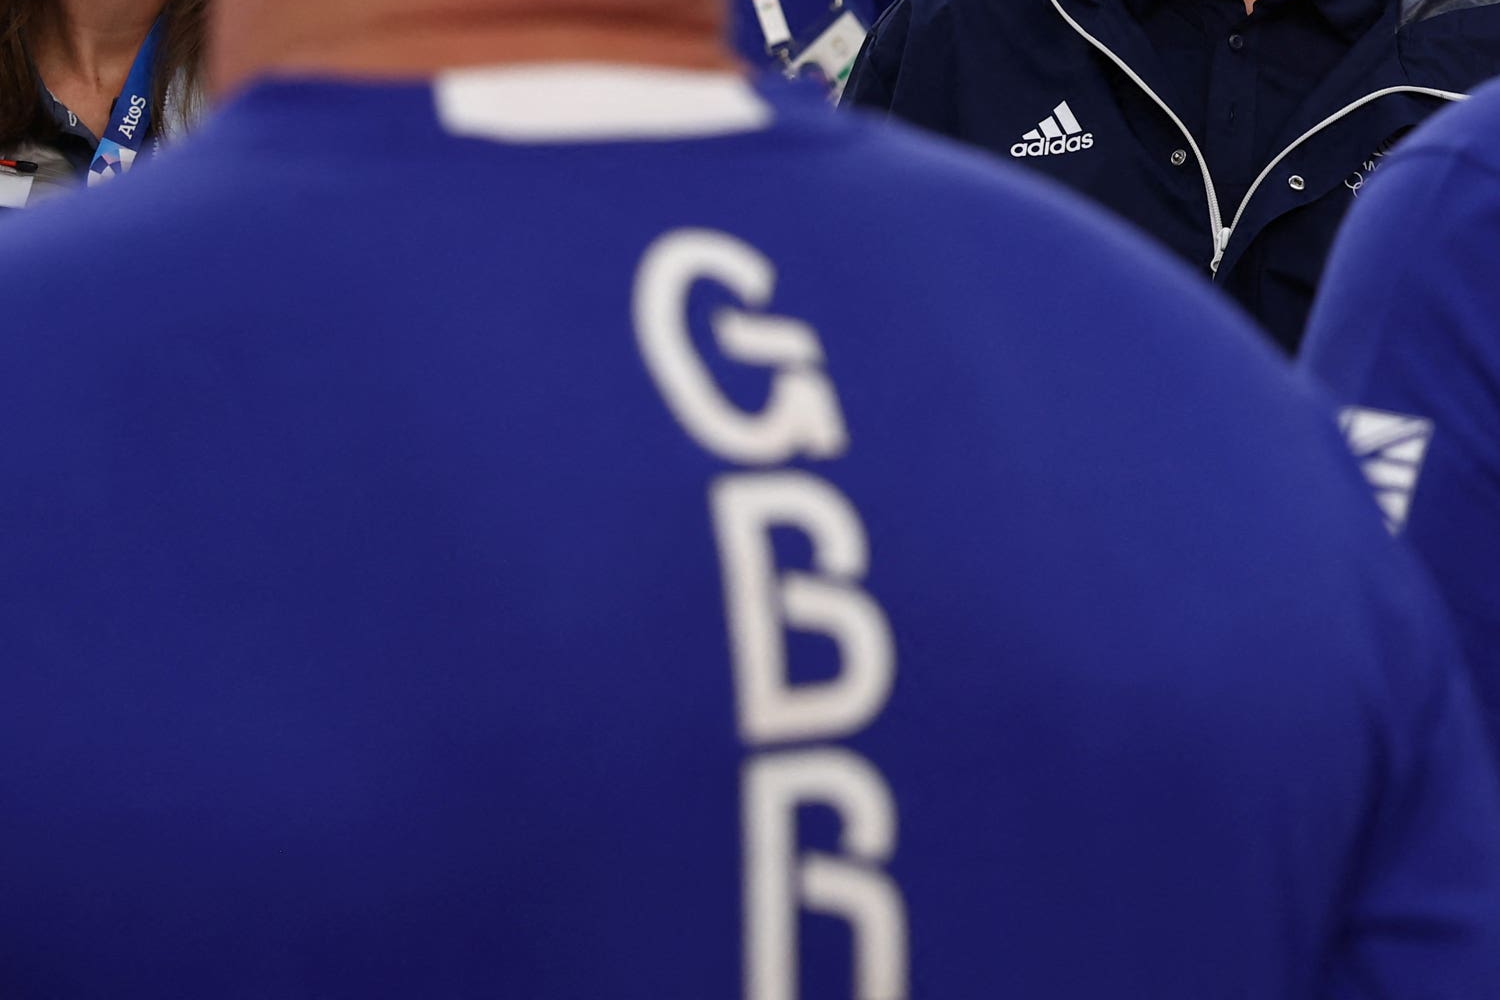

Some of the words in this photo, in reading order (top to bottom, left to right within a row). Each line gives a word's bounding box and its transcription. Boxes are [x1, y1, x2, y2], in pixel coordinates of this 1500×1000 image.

[118, 94, 147, 140] Atos
[1009, 132, 1095, 158] adidas
[629, 226, 910, 1000] GBR
